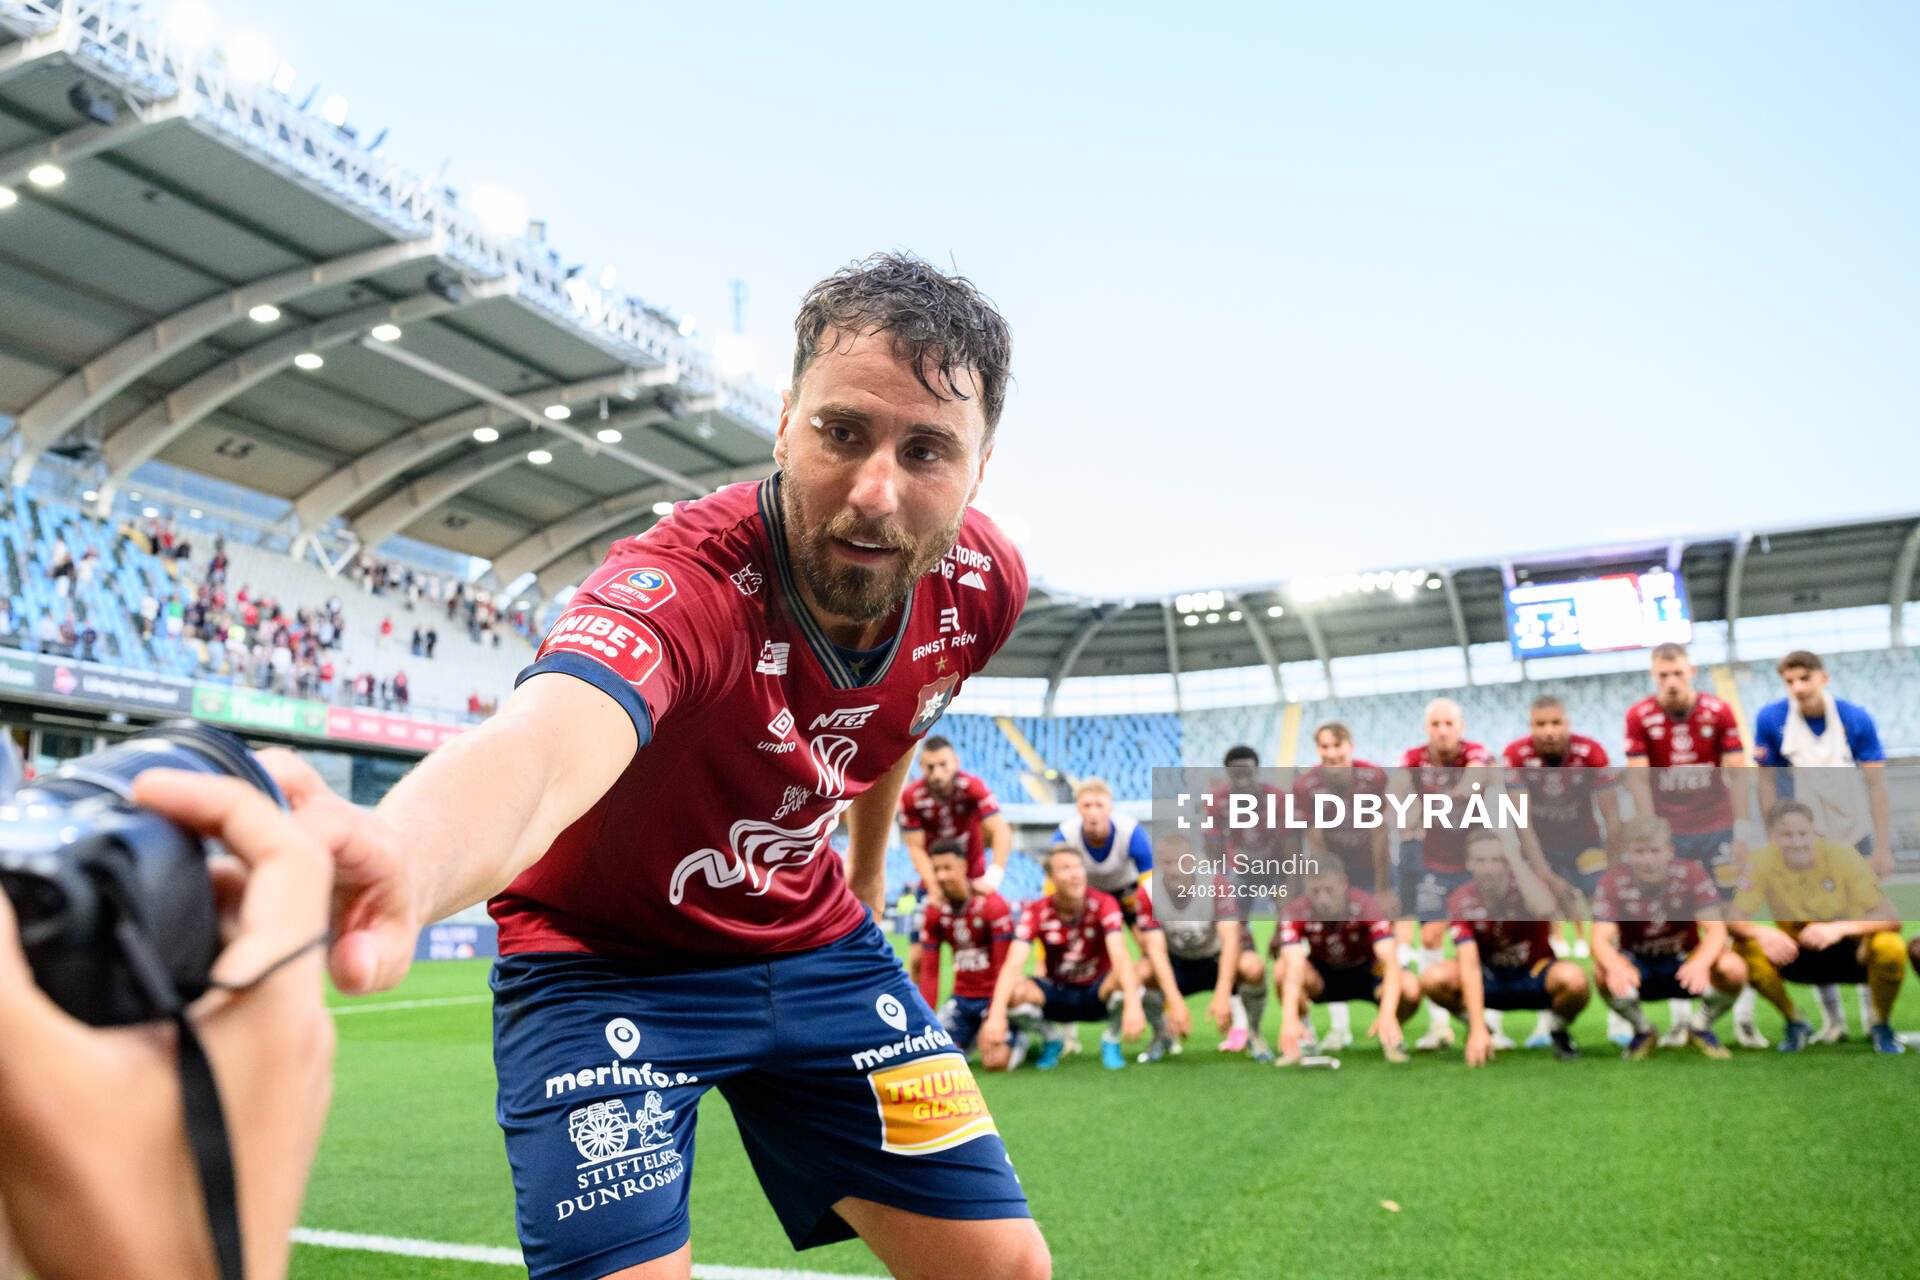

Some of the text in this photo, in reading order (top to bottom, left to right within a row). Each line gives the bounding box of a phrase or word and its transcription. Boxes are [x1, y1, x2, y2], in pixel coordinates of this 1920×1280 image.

[945, 544, 992, 572] LTORPS
[912, 630, 977, 662] ERNST RÉN
[757, 741, 796, 754] umbro
[913, 1096, 981, 1121] GLASS
